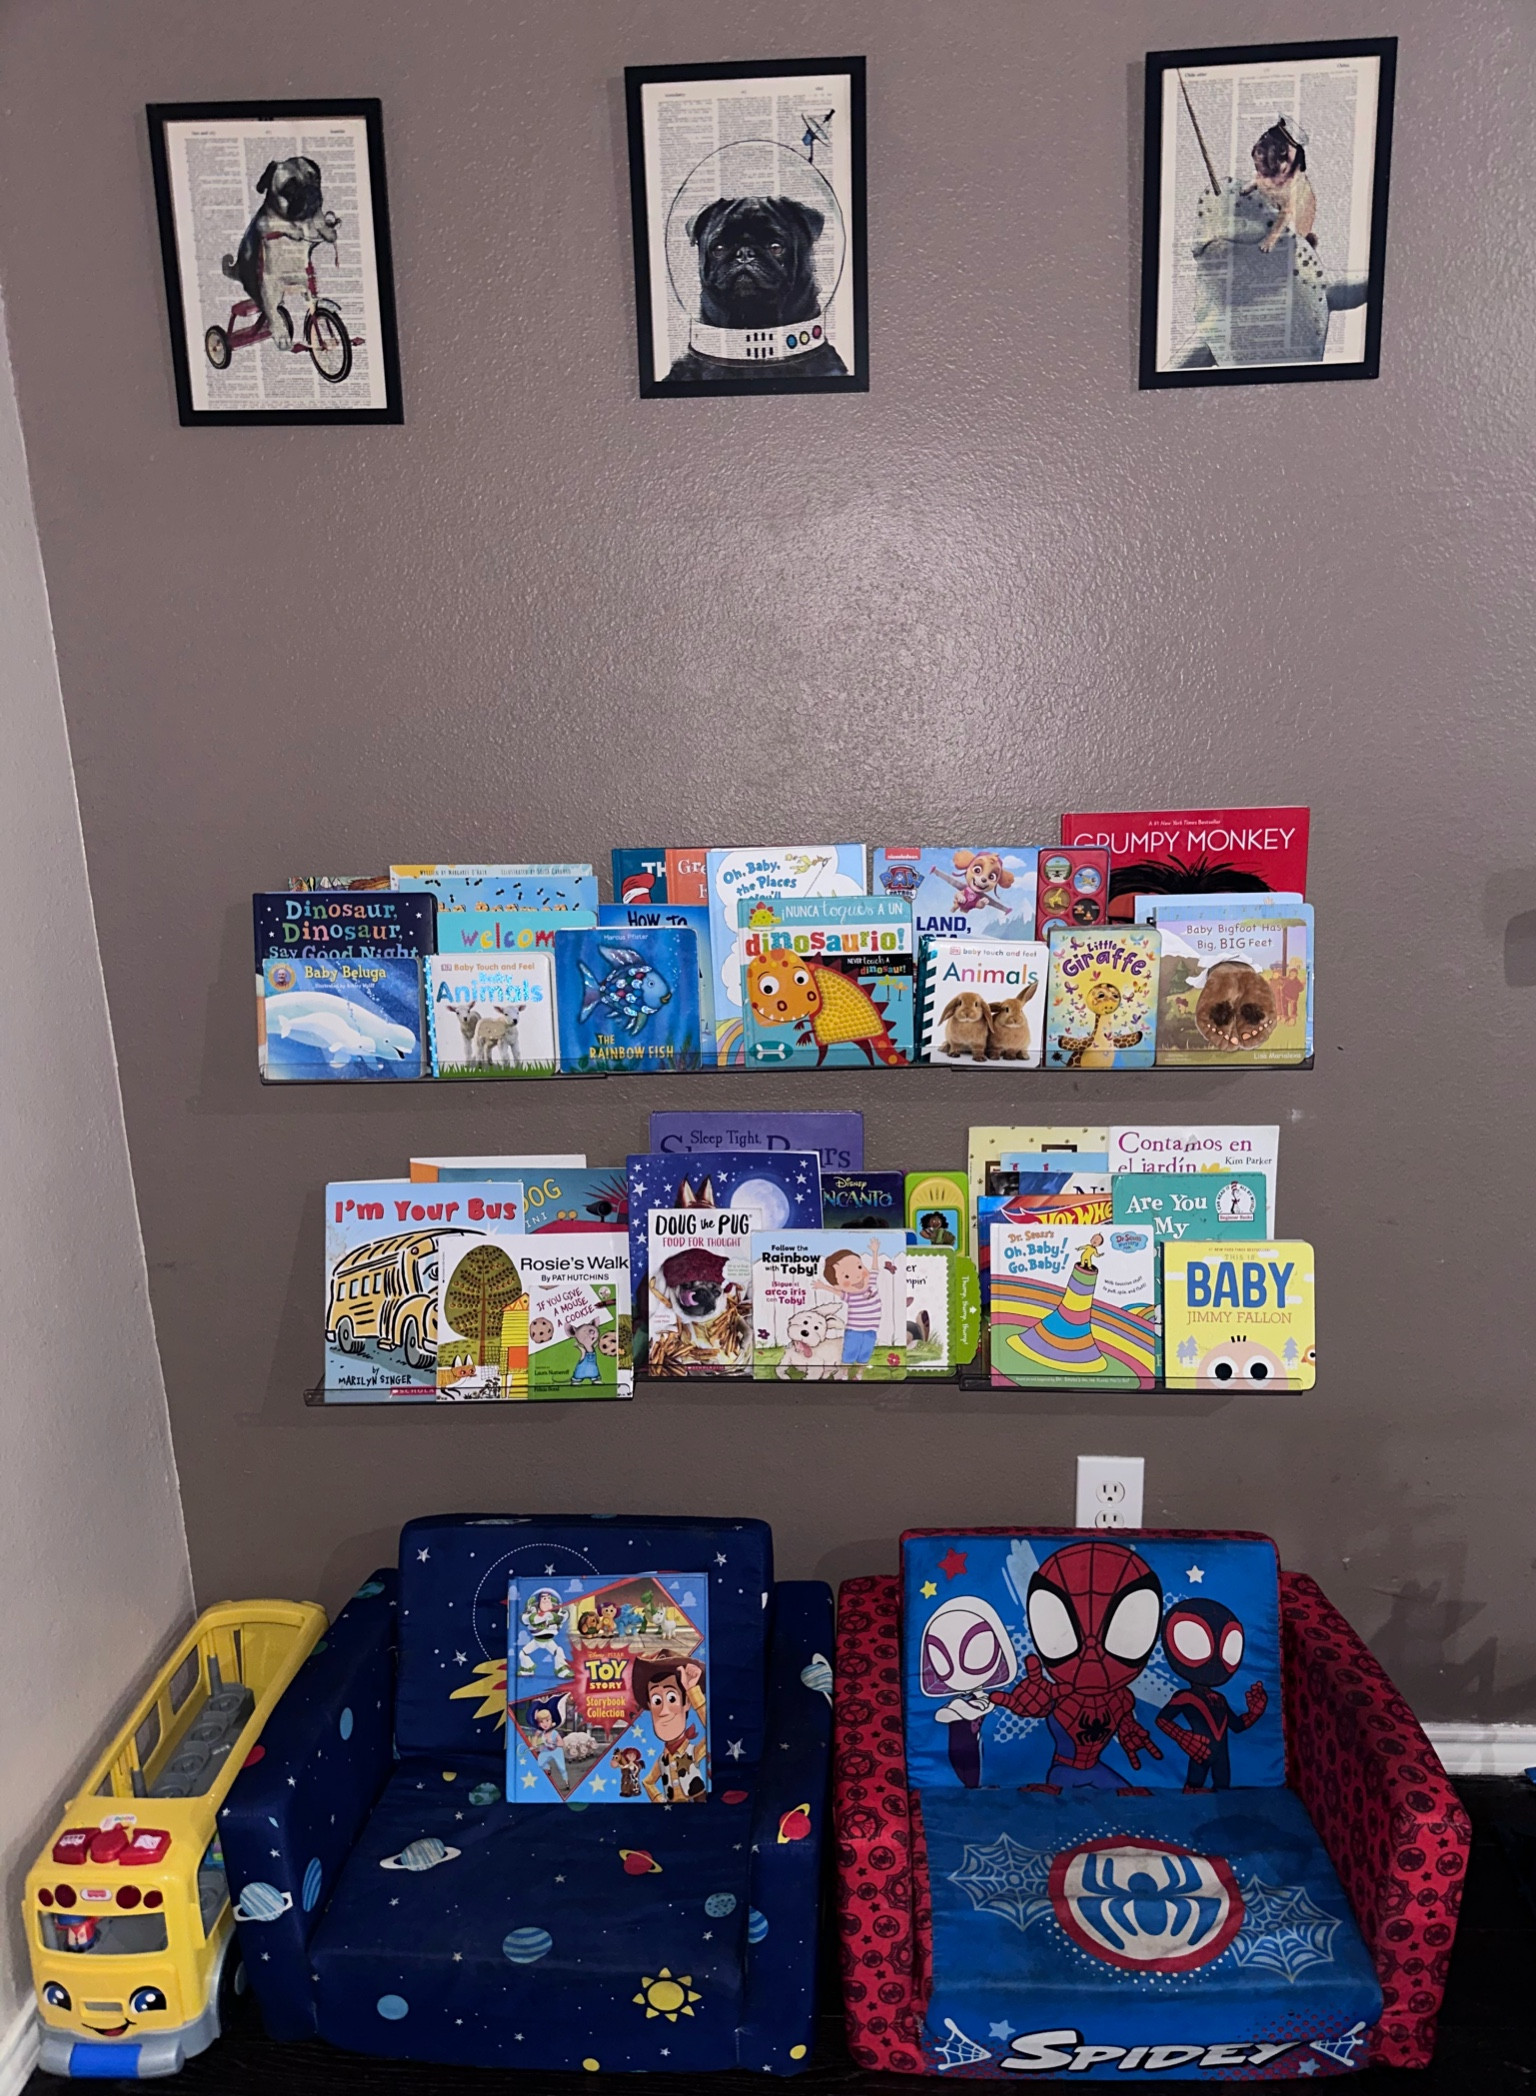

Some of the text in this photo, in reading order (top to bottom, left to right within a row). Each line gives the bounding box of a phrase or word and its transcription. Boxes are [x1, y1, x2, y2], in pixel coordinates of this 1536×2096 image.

[1073, 827, 1296, 854] GRUMPY MONKEY
[641, 861, 666, 877] TH
[677, 859, 708, 875] Gre
[723, 869, 746, 885] Oh,
[736, 883, 756, 896] the
[756, 875, 797, 889] Places
[285, 900, 398, 921] Dinosaur,
[821, 901, 874, 924] toques
[878, 903, 885, 915] A
[888, 903, 903, 915] UN
[282, 921, 403, 943] Dinosaur,
[916, 916, 972, 934] LAND,
[1187, 923, 1282, 936] Baby Bigfoot Has
[461, 922, 556, 949] welcom
[745, 927, 905, 956] dinosaurio!
[269, 944, 419, 958] Say Good Night
[963, 948, 982, 957] baby
[984, 948, 1004, 956] touch
[1087, 940, 1117, 952] Little
[1198, 938, 1272, 951] Big, BIG Feet
[454, 962, 535, 972] Baby Touch and Feel
[860, 964, 907, 975] dinosaur!
[1062, 948, 1147, 977] Giraffe
[304, 965, 338, 983] Baby
[342, 965, 387, 983] Beluga
[943, 961, 1039, 985] Animals
[436, 979, 544, 1003] Animals
[597, 1034, 615, 1045] THE
[589, 1045, 674, 1060] RAINBOW FISH
[690, 1130, 723, 1148] Sleep
[726, 1130, 762, 1148] Tight,
[1118, 1131, 1252, 1154] Contamos en
[1118, 1156, 1197, 1173] el jardín
[1225, 1156, 1272, 1165] Kim Parker
[833, 1176, 868, 1190] Disney
[821, 1188, 894, 1208] NCANTO
[1125, 1193, 1208, 1214] Are You
[335, 1197, 517, 1223] I'm Your Bus
[655, 1213, 750, 1236] DOUG the PUG
[1153, 1215, 1190, 1239] My
[662, 1236, 741, 1247] FOOD FOR THOUGHT
[1008, 1232, 1023, 1243] Dr.
[1004, 1237, 1068, 1259] Oh, Baby!
[520, 1256, 629, 1271] Rosie's Walk
[762, 1251, 821, 1263] Rainbow
[1008, 1253, 1069, 1274] Go, Baby!
[541, 1274, 551, 1283] By
[567, 1273, 609, 1281] HUTCHINS
[780, 1263, 818, 1277] Toby!
[790, 1288, 806, 1296] iris
[1187, 1261, 1295, 1308] BABY
[536, 1286, 583, 1312] IF YOU GIVE
[553, 1296, 589, 1317] A MOUSE
[778, 1296, 805, 1306] Toby!
[557, 1304, 595, 1327] A COOKIE
[1186, 1311, 1292, 1325] JIMMY FALLON
[372, 1366, 380, 1376] by
[380, 1374, 412, 1385] SINGER
[585, 1659, 628, 1681] TOY
[590, 1682, 622, 1690] STORY
[586, 1696, 626, 1708] Storybook
[587, 1708, 625, 1718] Collection
[1000, 2029, 1310, 2072] SPIDEY
